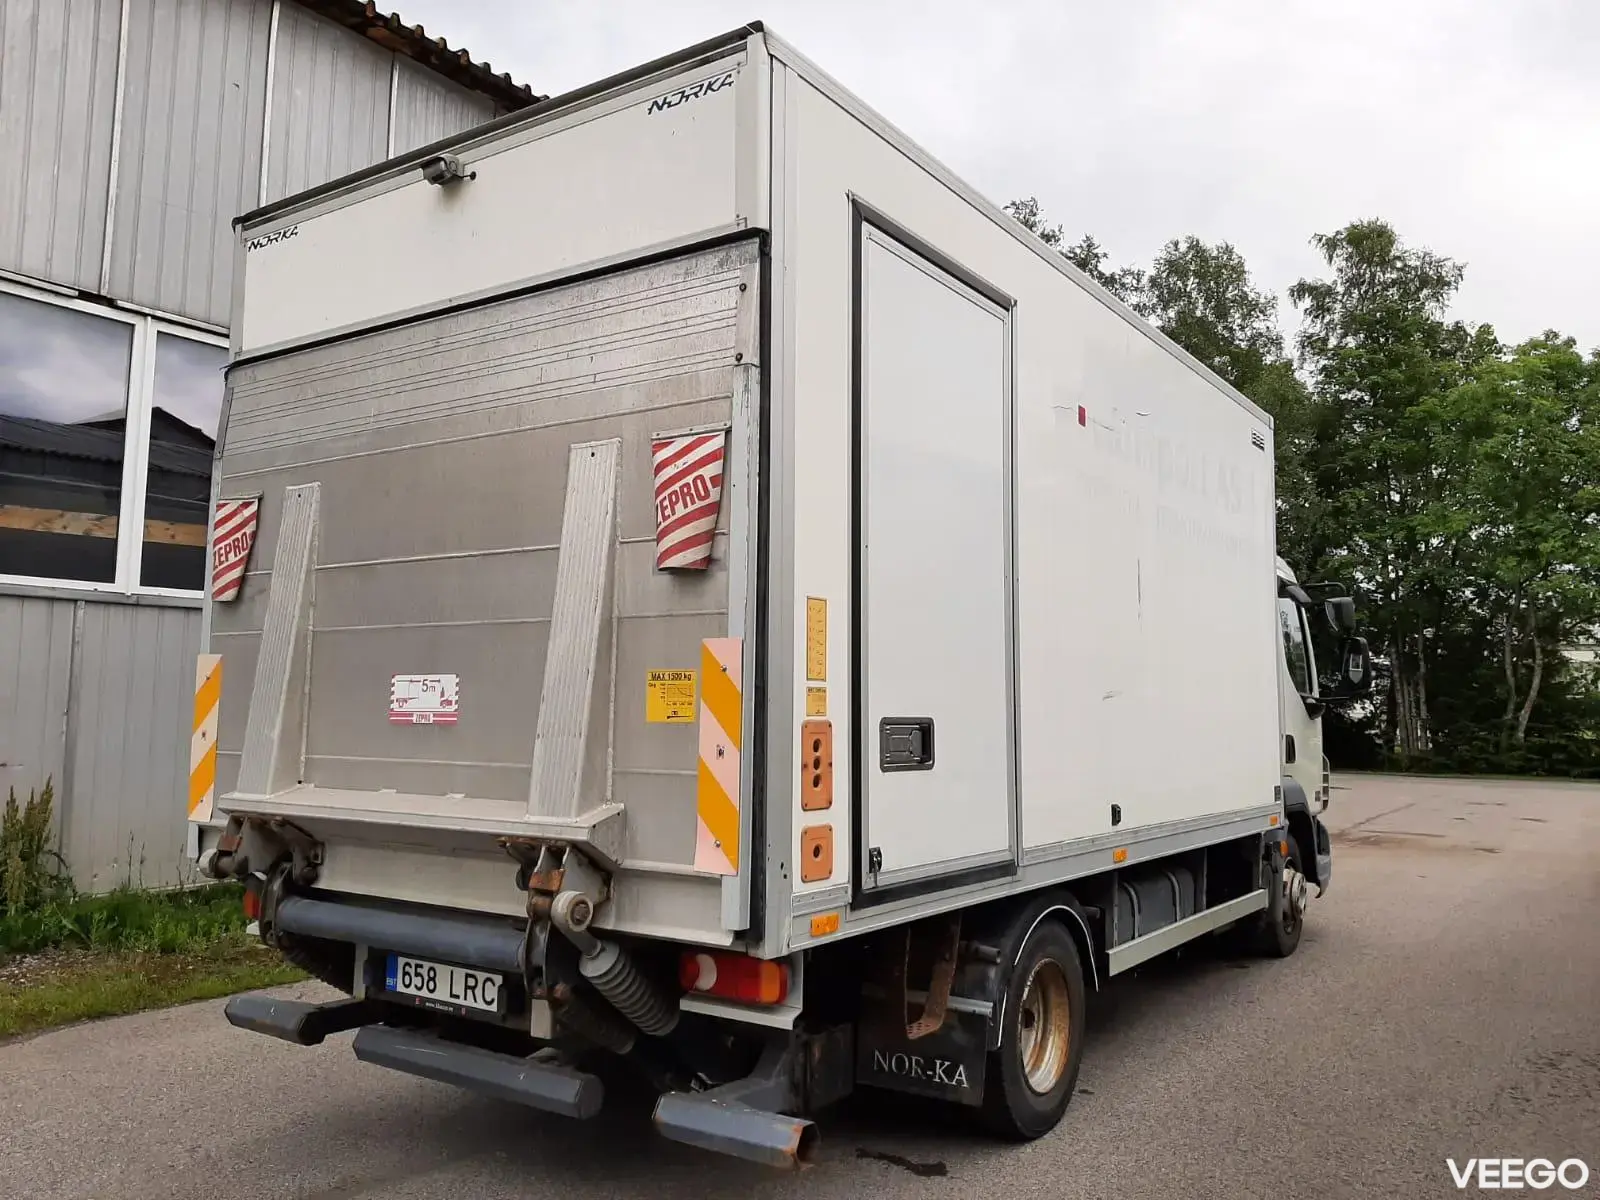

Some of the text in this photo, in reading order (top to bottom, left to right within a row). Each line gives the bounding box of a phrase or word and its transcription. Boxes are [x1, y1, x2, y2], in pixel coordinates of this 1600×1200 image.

[651, 672, 666, 681] MAX
[402, 962, 496, 1006] 658 LRC
[873, 1048, 969, 1088] NOR-KA
